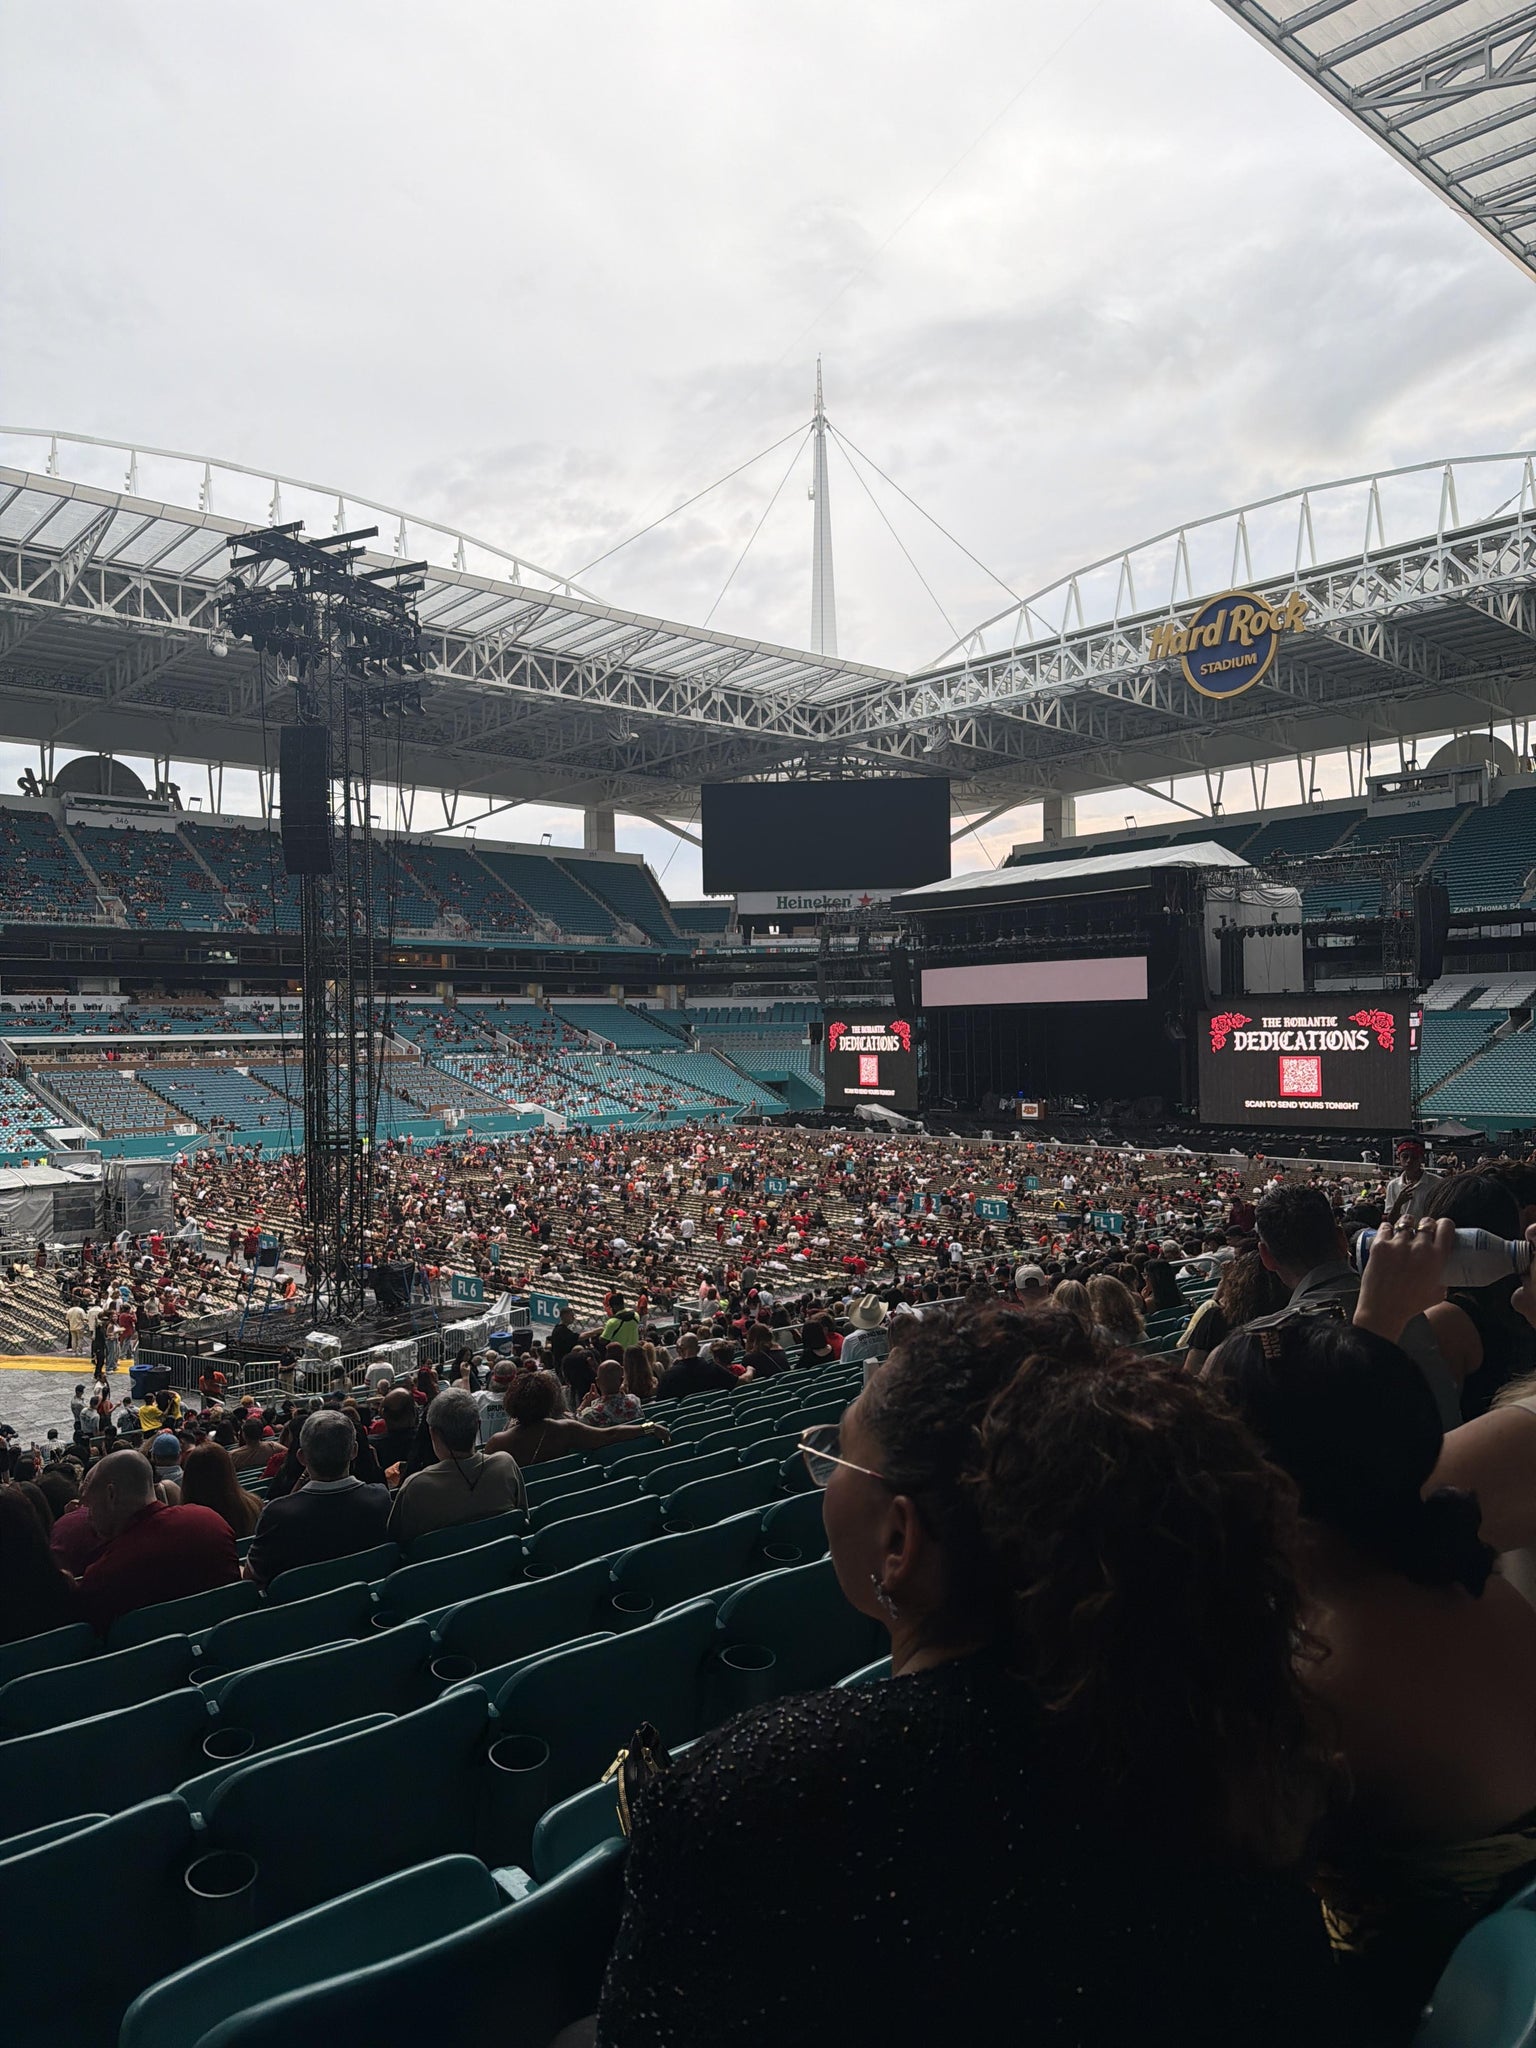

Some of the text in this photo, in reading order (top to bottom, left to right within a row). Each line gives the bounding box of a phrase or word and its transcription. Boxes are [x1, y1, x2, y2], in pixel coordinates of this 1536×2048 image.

[1149, 591, 1309, 661] Hard Rock
[1200, 652, 1258, 676] STADIUM
[115, 817, 129, 825] 346
[776, 895, 852, 909] Heineken
[1476, 904, 1507, 912] THOMAS
[1509, 902, 1521, 910] 54
[1261, 1016, 1338, 1028] THE ROMANTIC
[839, 1035, 900, 1051] DEDICATIONS
[1233, 1030, 1369, 1051] DEDICATIONS
[1244, 1100, 1266, 1108] SCAN
[1277, 1101, 1298, 1109] SEND
[1298, 1101, 1324, 1110] YOURS
[1324, 1102, 1360, 1111] TONIGHT
[769, 1181, 783, 1191] FL 2
[982, 1203, 1000, 1216] FL 1
[1094, 1216, 1115, 1229] FL 1
[457, 1280, 477, 1298] FL 6
[537, 1300, 560, 1319] FL 6
